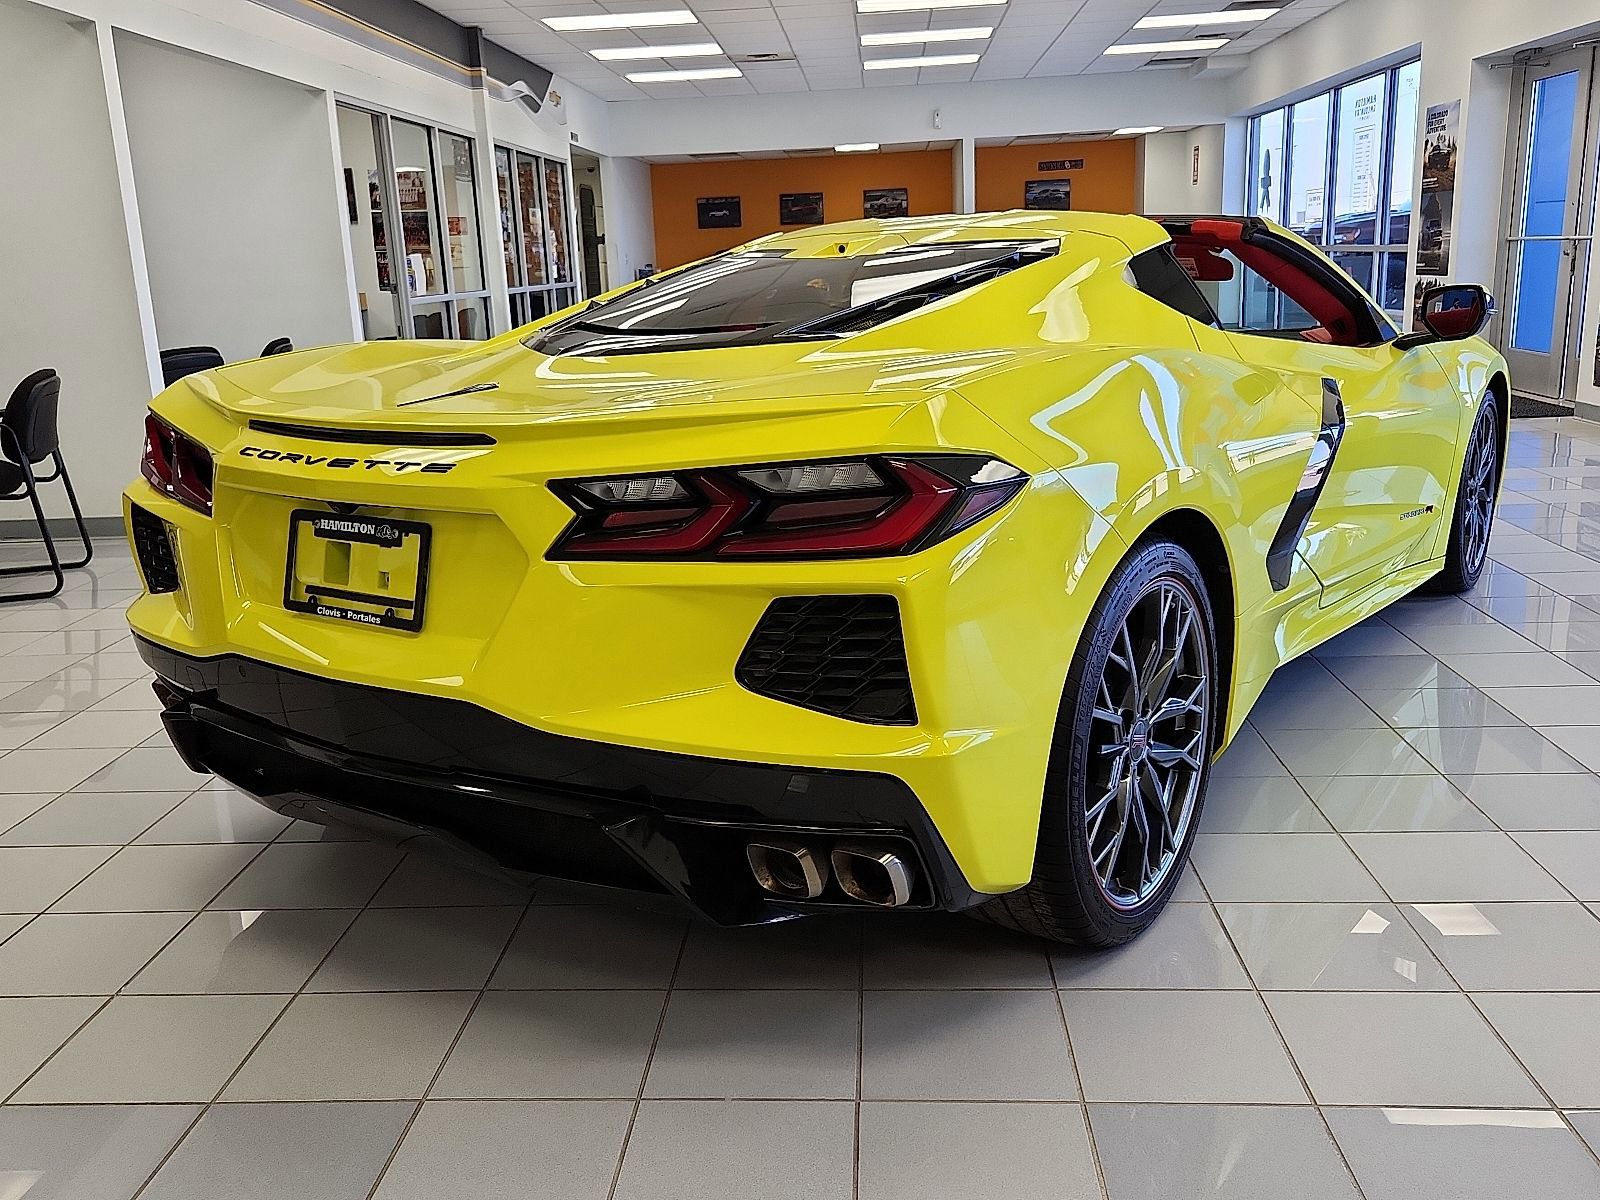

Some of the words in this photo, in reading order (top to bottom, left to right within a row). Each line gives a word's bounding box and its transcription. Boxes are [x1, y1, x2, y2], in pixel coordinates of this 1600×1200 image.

[239, 446, 458, 474] CORVETTE
[320, 518, 376, 535] HAMILTON
[316, 606, 341, 618] Clovis
[347, 611, 381, 625] Portales
